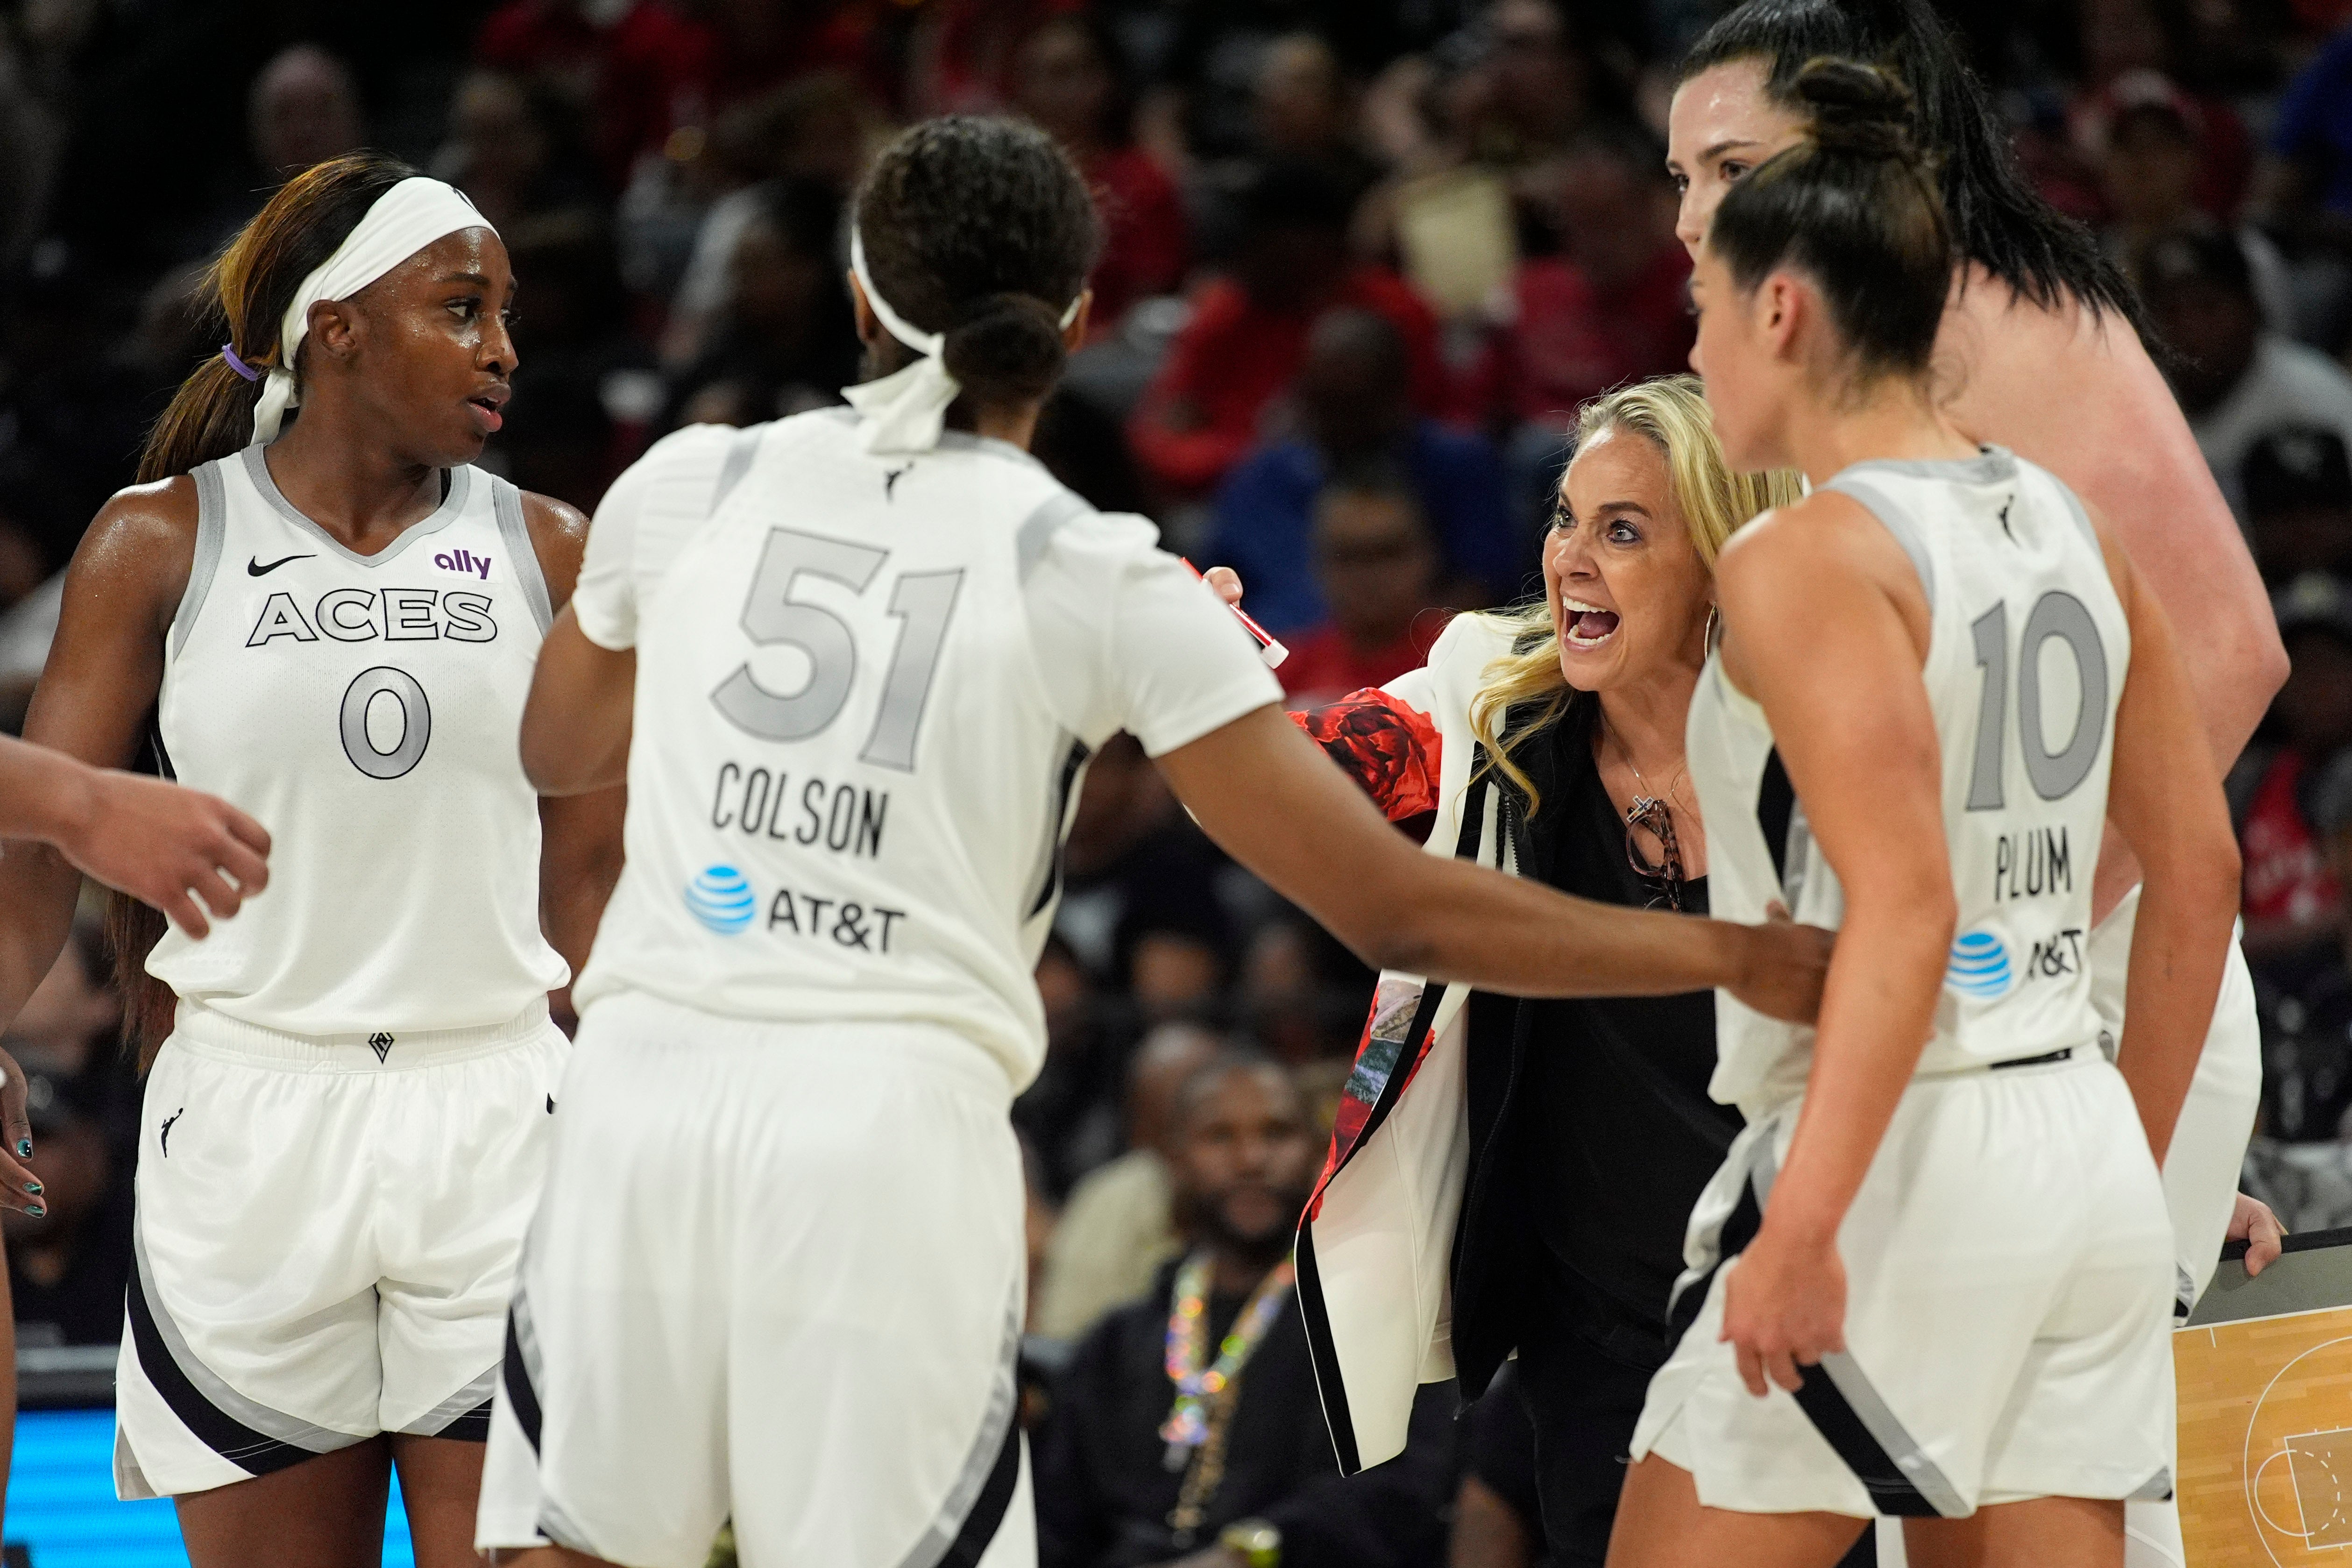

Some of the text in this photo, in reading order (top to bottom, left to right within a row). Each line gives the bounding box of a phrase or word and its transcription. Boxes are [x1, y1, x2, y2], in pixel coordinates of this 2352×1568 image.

[435, 550, 491, 579] ally
[246, 589, 497, 647] ACES
[710, 527, 964, 773] 51
[340, 666, 431, 780] 0
[1965, 590, 2108, 811] 10
[712, 762, 888, 859] COLSON
[1995, 826, 2072, 901] PLUM
[768, 889, 907, 954] AT&T
[2027, 929, 2082, 979] &T
